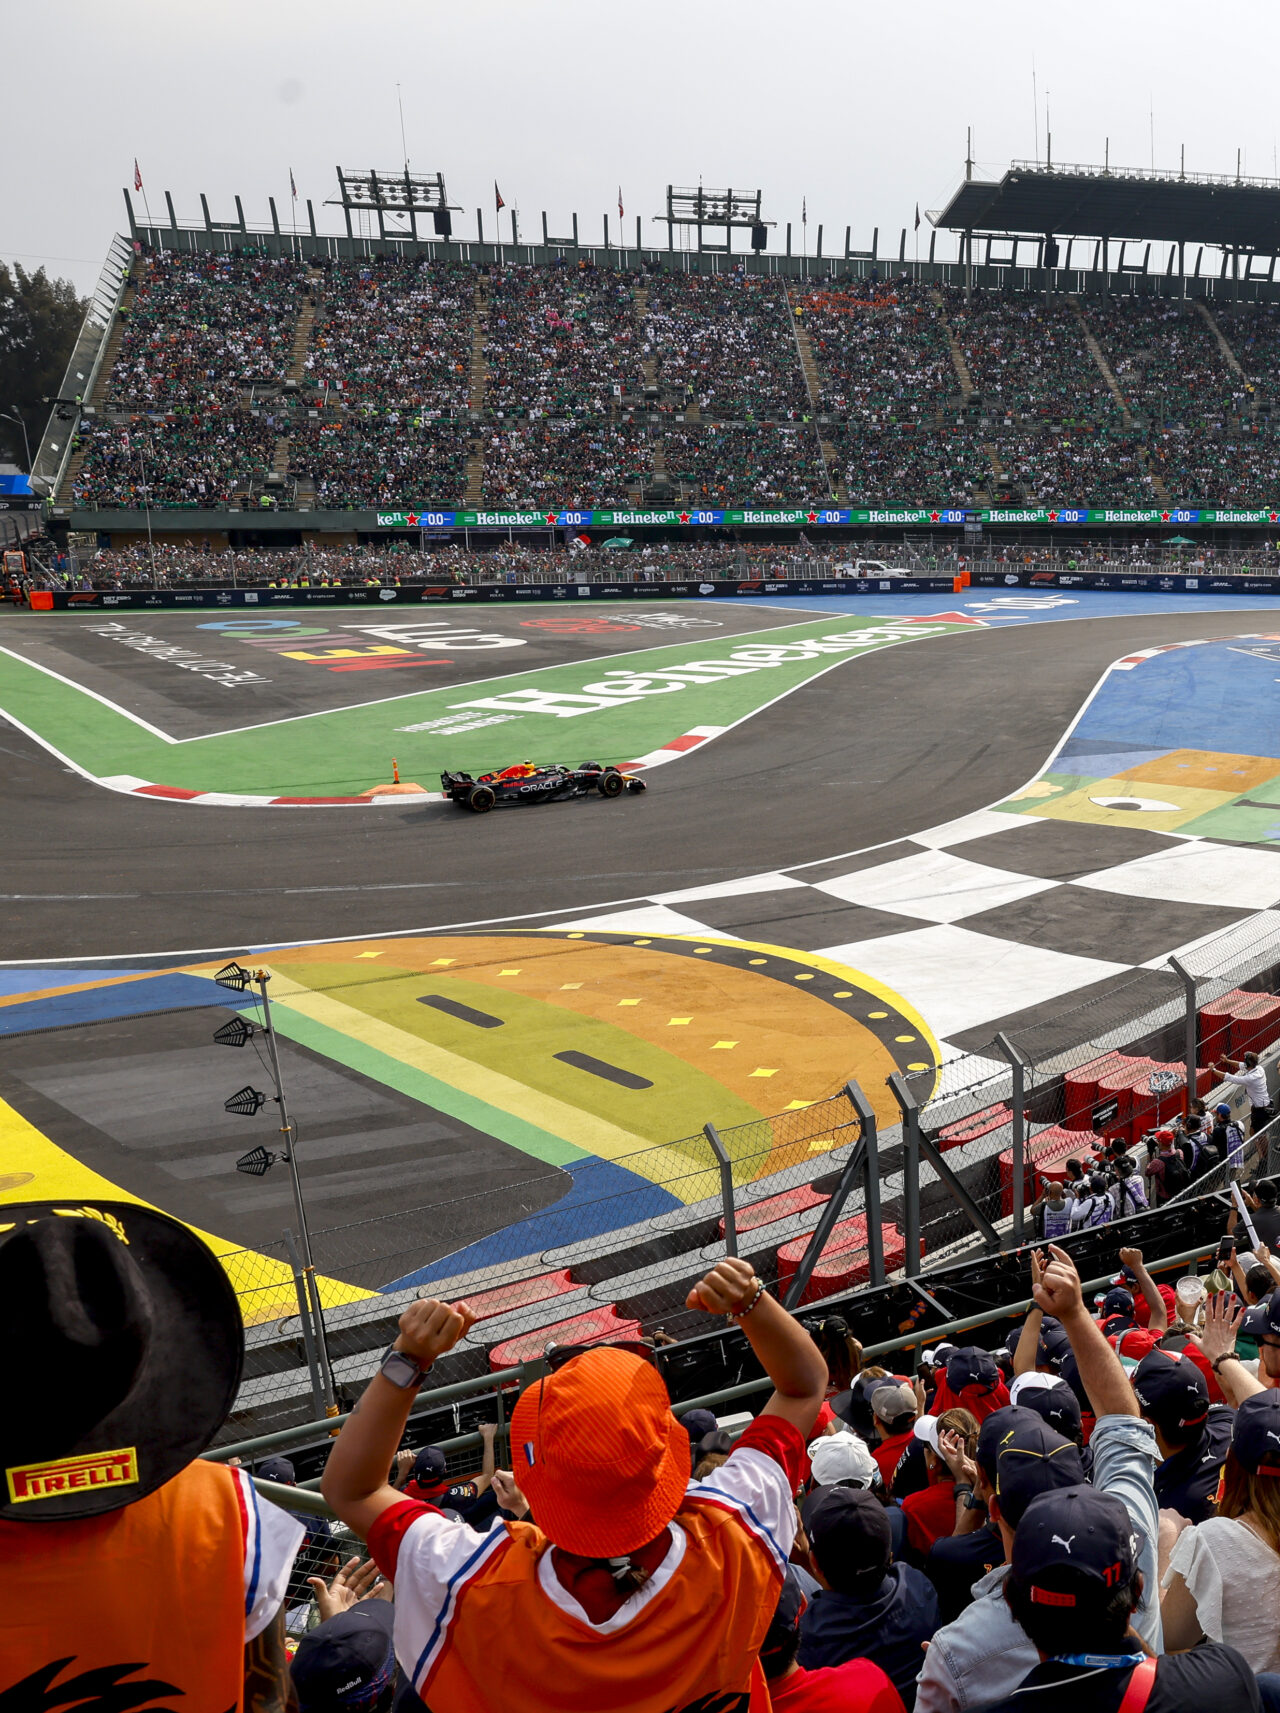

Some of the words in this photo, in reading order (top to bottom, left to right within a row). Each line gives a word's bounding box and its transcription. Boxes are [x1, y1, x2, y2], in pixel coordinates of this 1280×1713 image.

[477, 511, 542, 525] Heineken
[612, 510, 675, 524] Heineken
[743, 510, 803, 523] Heineken
[869, 509, 927, 523] Heineken
[989, 509, 1045, 522] Heineken
[1105, 509, 1158, 522] Heineken
[1216, 509, 1266, 522] Heineken
[195, 619, 455, 673] MEXICO
[445, 622, 947, 719] Heineken
[520, 779, 564, 793] ORACLE
[1135, 1387, 1151, 1407] telcel
[12, 1452, 132, 1498] PIRELLI
[1101, 1562, 1123, 1588] 11
[336, 1676, 362, 1695] RedBull
